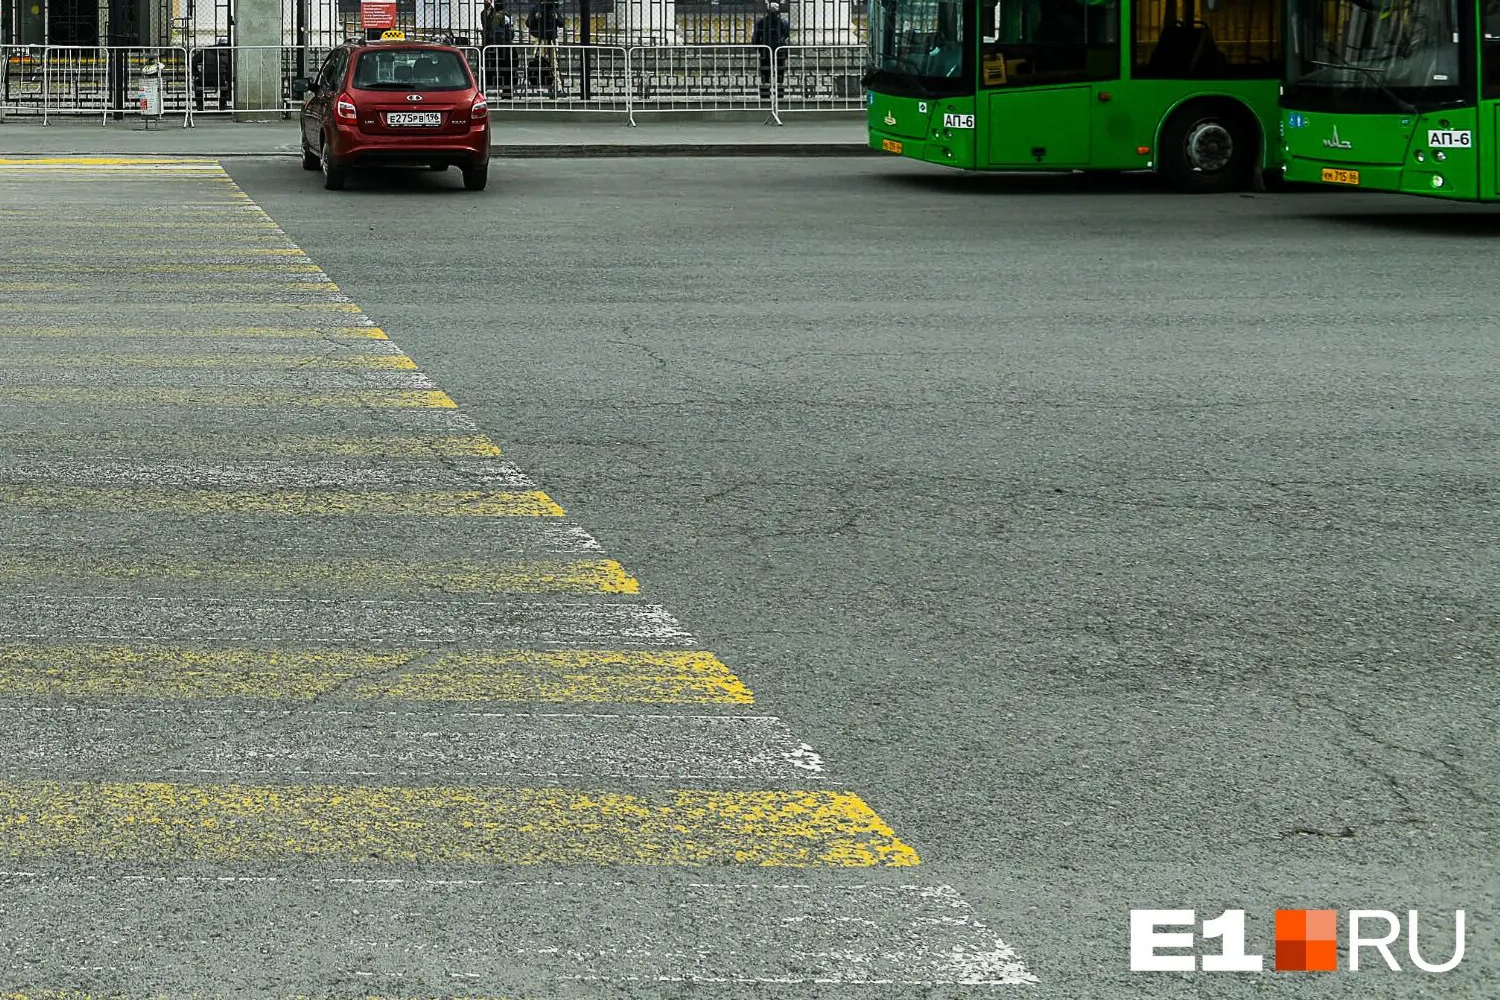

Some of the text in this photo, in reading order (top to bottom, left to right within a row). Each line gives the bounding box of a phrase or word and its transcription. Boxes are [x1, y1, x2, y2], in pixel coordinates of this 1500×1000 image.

[425, 113, 439, 121] 196
[946, 114, 973, 127] АП-6
[1430, 132, 1469, 146] АП-6
